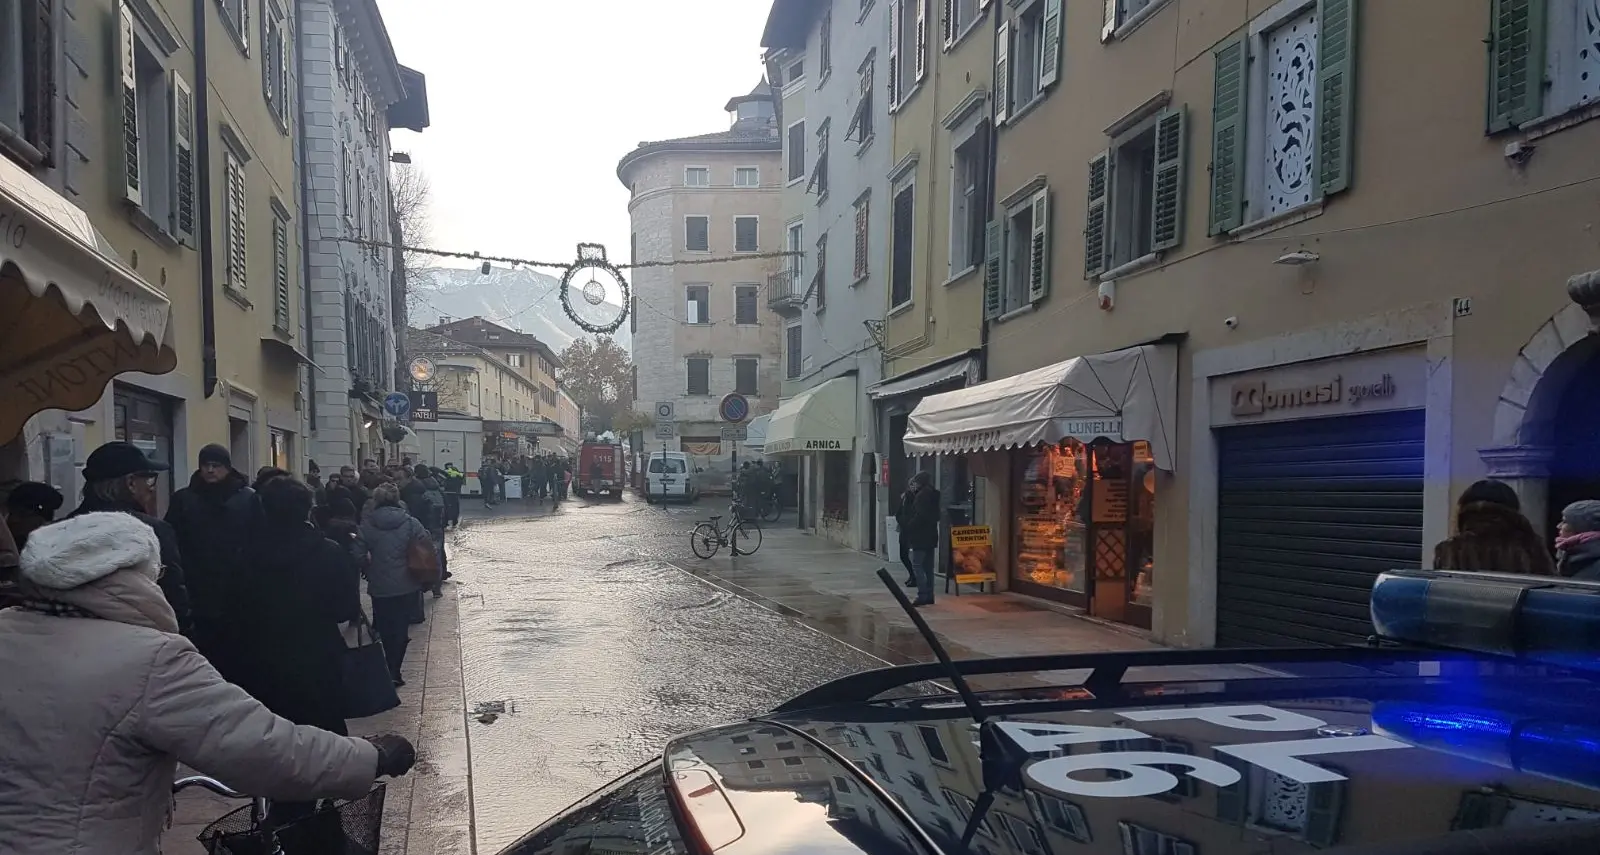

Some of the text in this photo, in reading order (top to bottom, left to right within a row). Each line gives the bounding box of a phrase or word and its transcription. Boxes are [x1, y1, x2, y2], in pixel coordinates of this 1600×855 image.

[1456, 299, 1471, 315] 44
[806, 440, 841, 449] ARNICA
[598, 455, 612, 463] 115
[1115, 705, 1413, 783] PL
[997, 721, 1242, 798] 46
